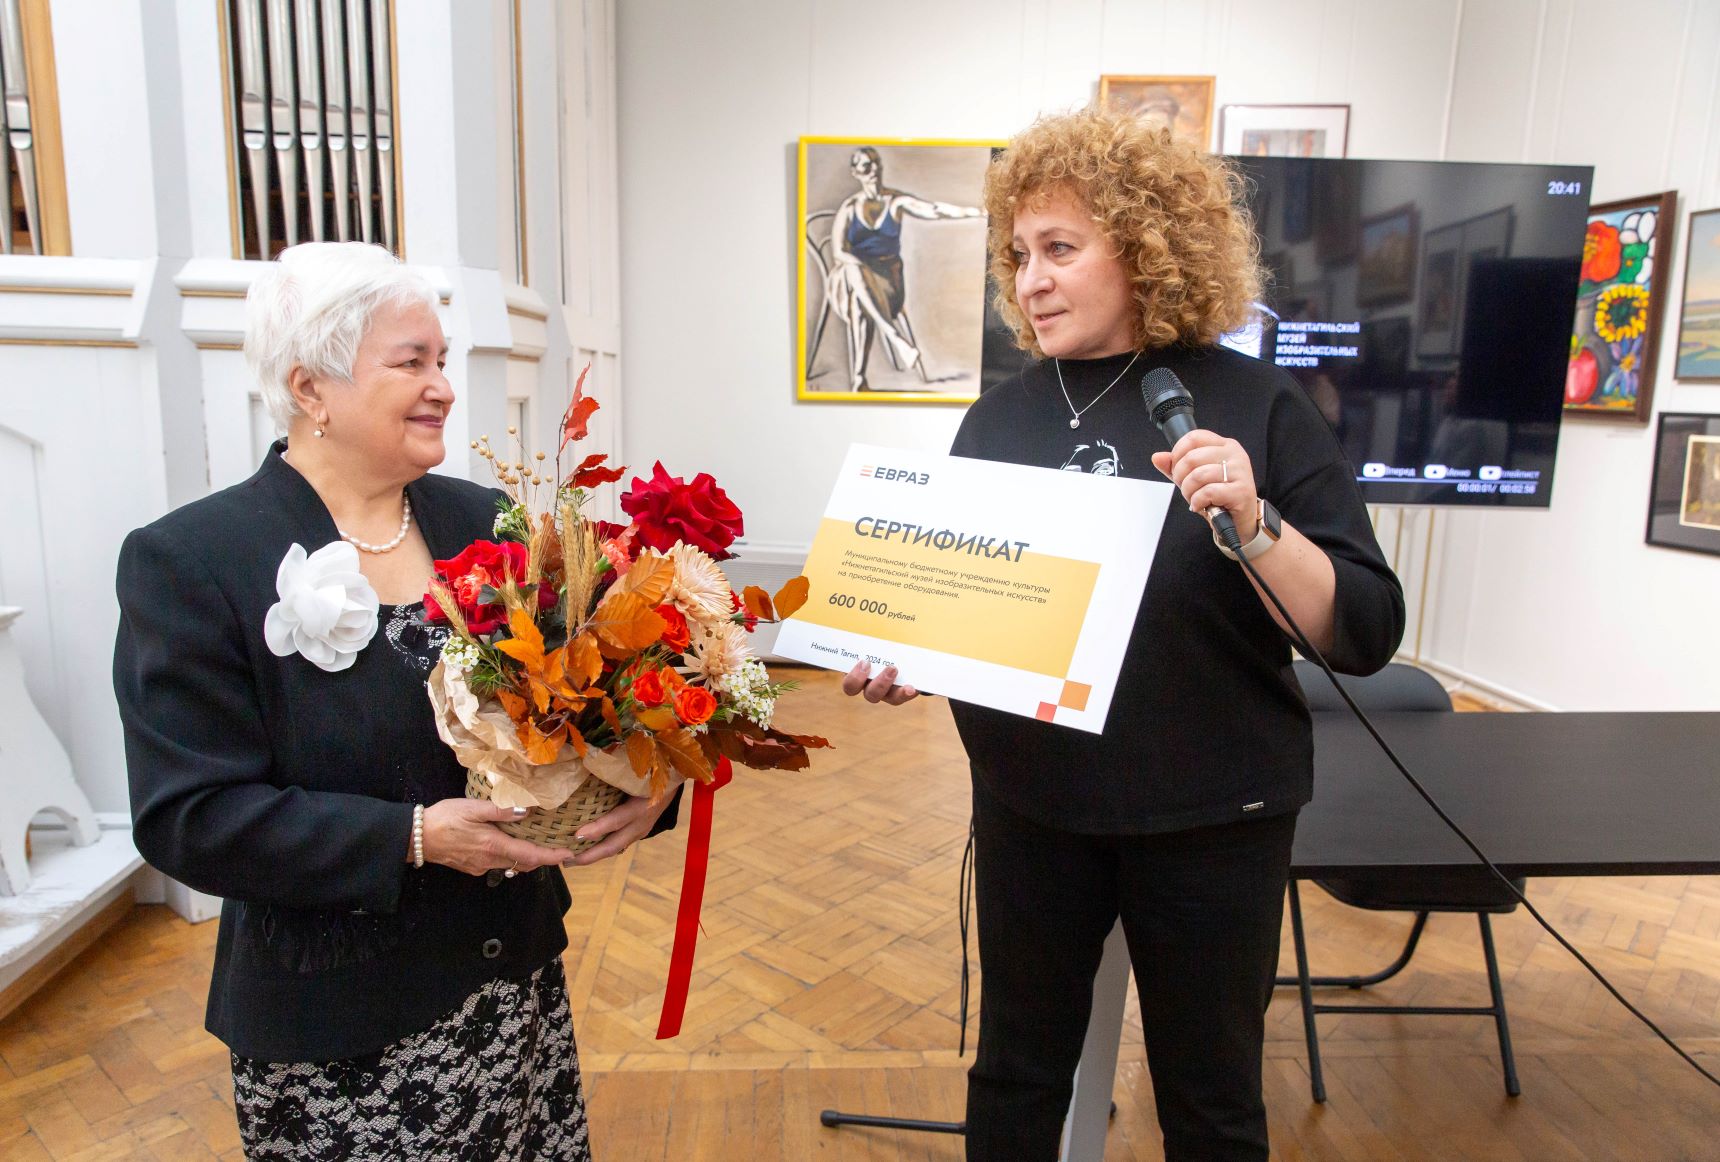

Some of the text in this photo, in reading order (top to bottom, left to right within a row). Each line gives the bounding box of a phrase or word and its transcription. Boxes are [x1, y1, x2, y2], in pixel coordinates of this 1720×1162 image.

[1547, 181, 1580, 195] 20:41
[1276, 332, 1307, 343] МУЗЕЙ
[1274, 356, 1318, 367] ИСКУССТВ
[1275, 345, 1358, 356] ИЗОБРАЗИТЕЛЬНЫХ
[874, 467, 930, 485] ЕВРАЗ
[855, 516, 1030, 563] СЕРТИФИКАТ
[841, 560, 1047, 604] «Нижнетагильский музей изобразительных искусств»
[844, 550, 1051, 594] Муниципальному бюджетному учреждению культуры
[848, 572, 902, 588] приобретение
[903, 583, 960, 598] оборудования.
[828, 592, 916, 621] 600 000 рублей
[810, 641, 839, 654] Нижний
[840, 648, 860, 660] Тагил,
[865, 655, 881, 664] 2024
